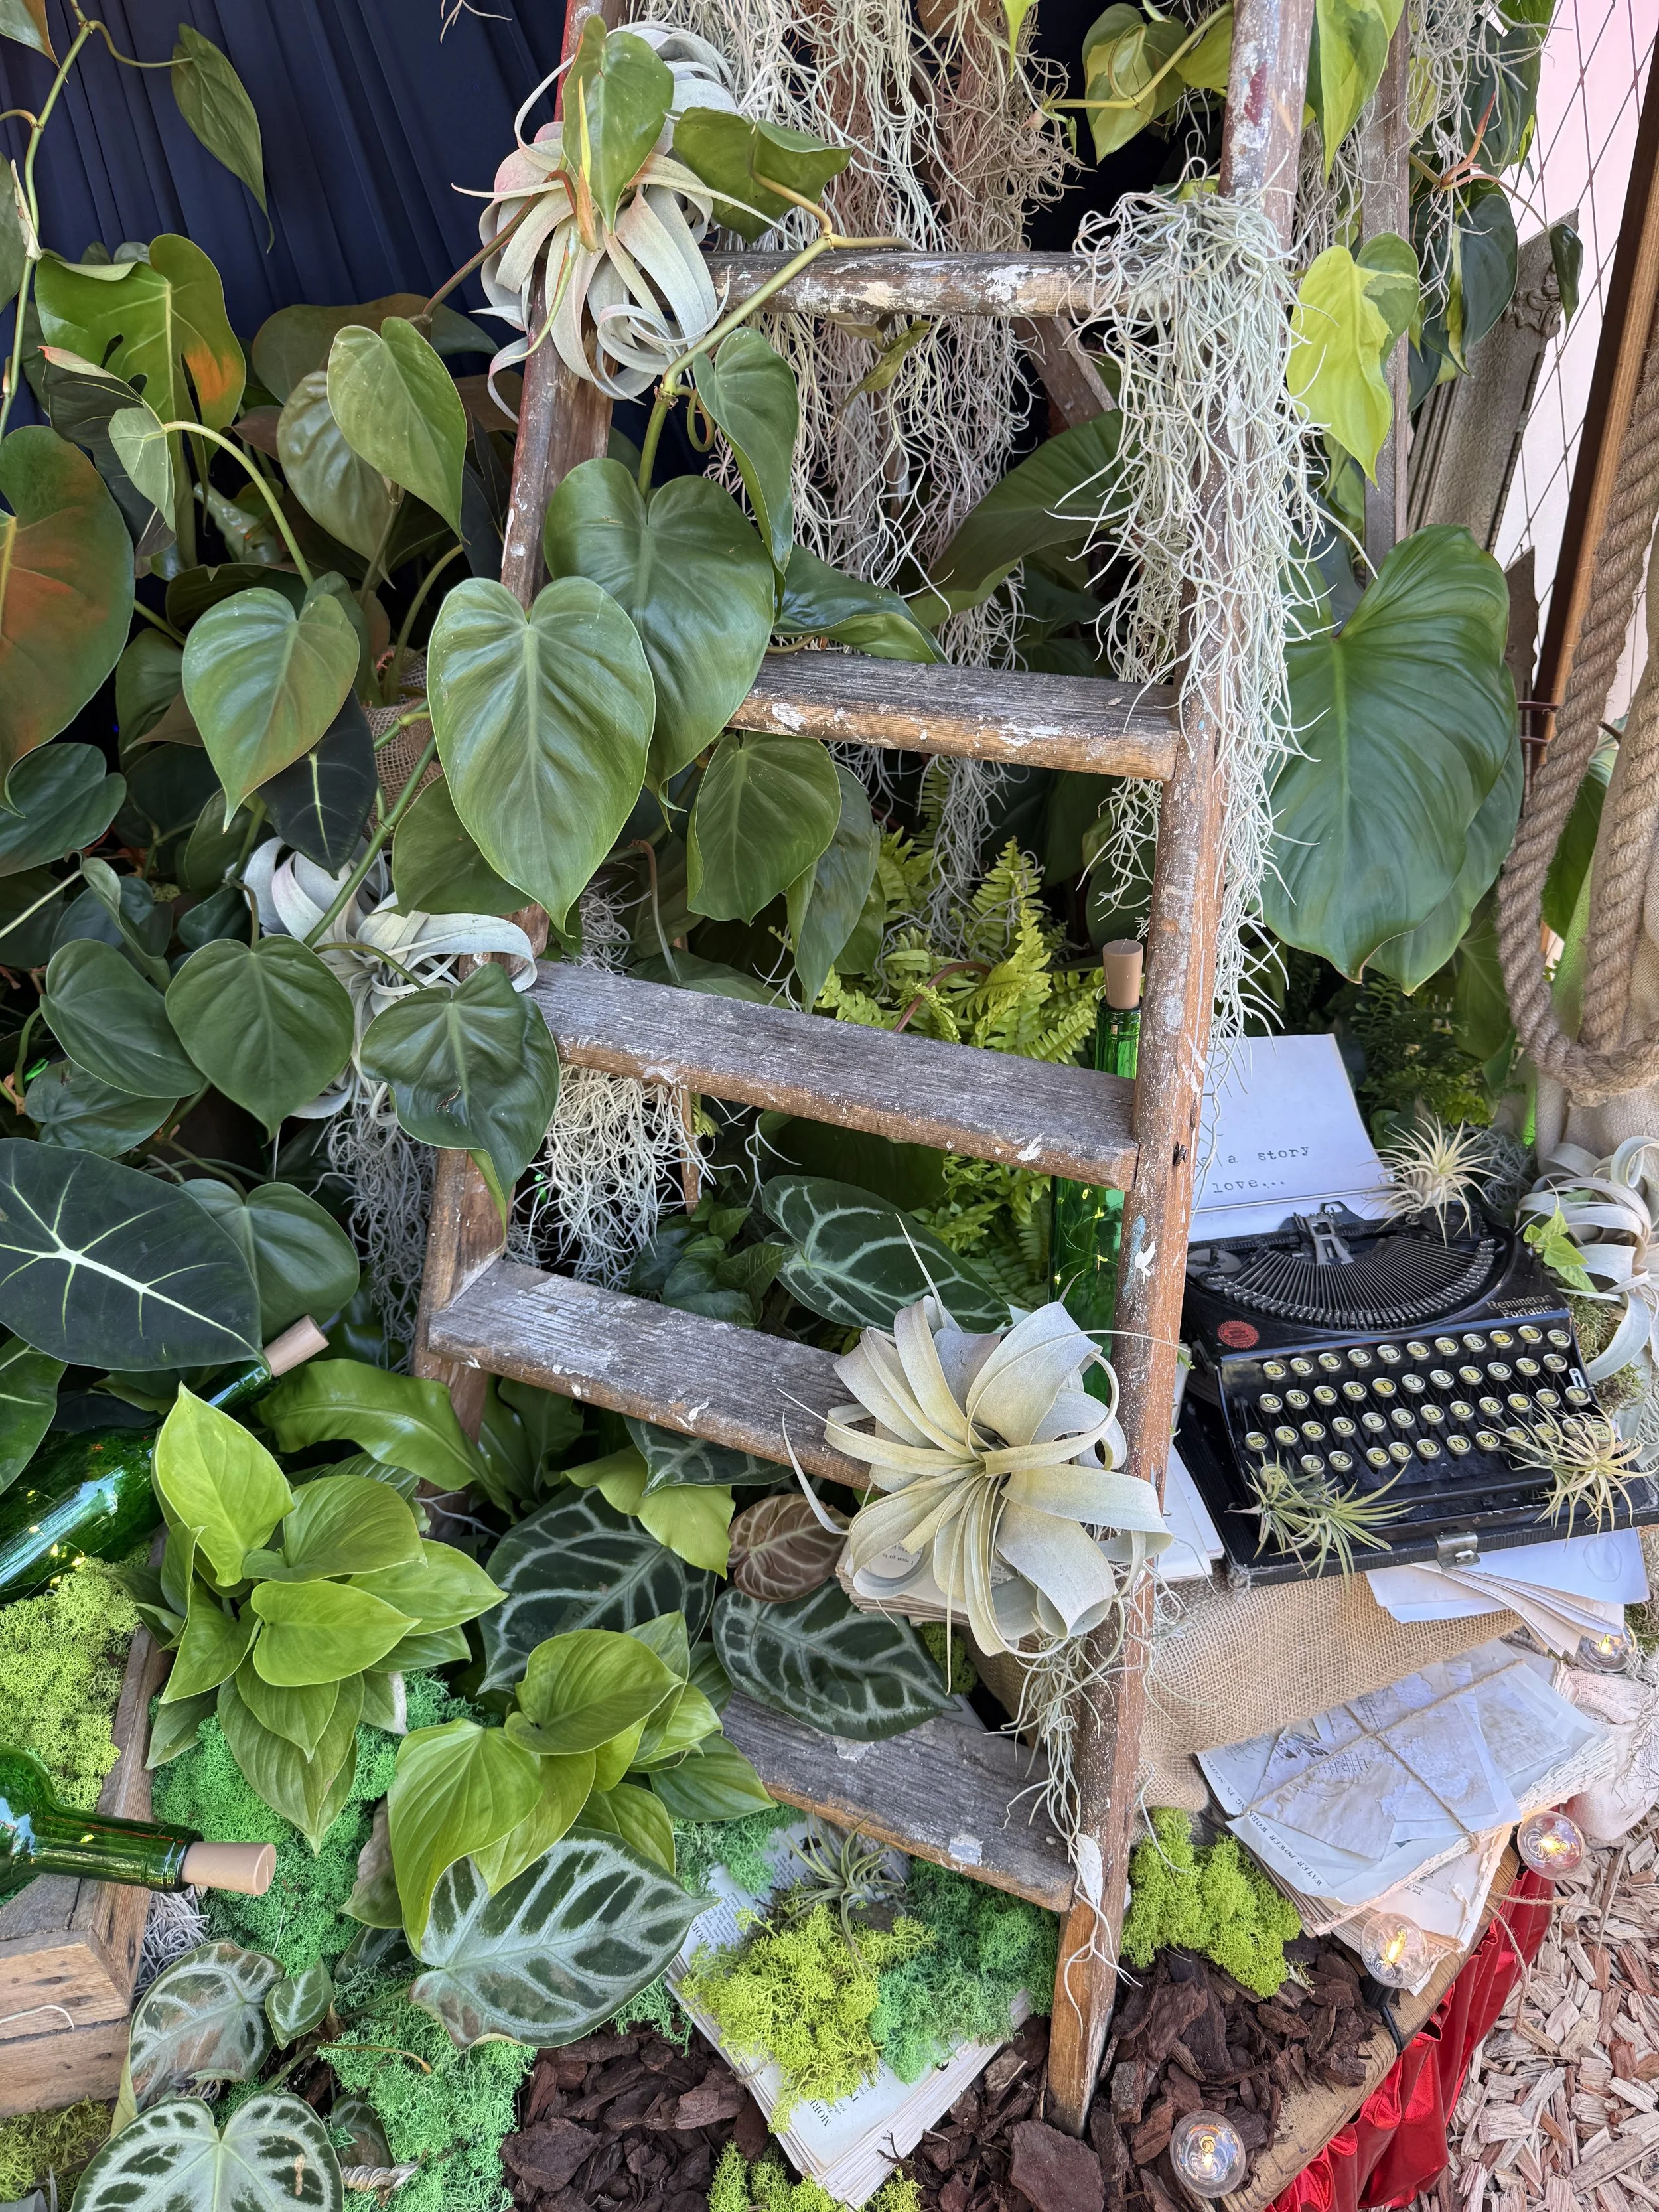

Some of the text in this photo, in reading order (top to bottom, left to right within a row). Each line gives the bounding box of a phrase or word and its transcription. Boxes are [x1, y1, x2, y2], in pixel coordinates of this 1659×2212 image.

[1228, 1155, 1238, 1164] a
[1258, 1146, 1310, 1162] story
[1212, 1176, 1285, 1194] love...
[1486, 1295, 1553, 1311] Remington
[1500, 1305, 1553, 1319] Portable
[1265, 1398, 1276, 1408] Q
[1291, 1394, 1302, 1403] W
[1350, 1386, 1360, 1394] R
[1284, 1430, 1293, 1439] A
[1338, 1421, 1348, 1430] D
[1398, 1413, 1409, 1422] G
[1427, 1409, 1437, 1418] H
[1486, 1402, 1497, 1410] K
[1307, 1459, 1318, 1468] Z
[1373, 1452, 1384, 1461] C
[1395, 1447, 1404, 1456] V
[1423, 1443, 1434, 1452] B
[1453, 1439, 1466, 1448] N
[1226, 1787, 1235, 1797] IN
[1236, 1799, 1267, 1833] WORKNG
[1269, 1834, 1296, 1860] POWER
[1297, 1860, 1322, 1887] WATER
